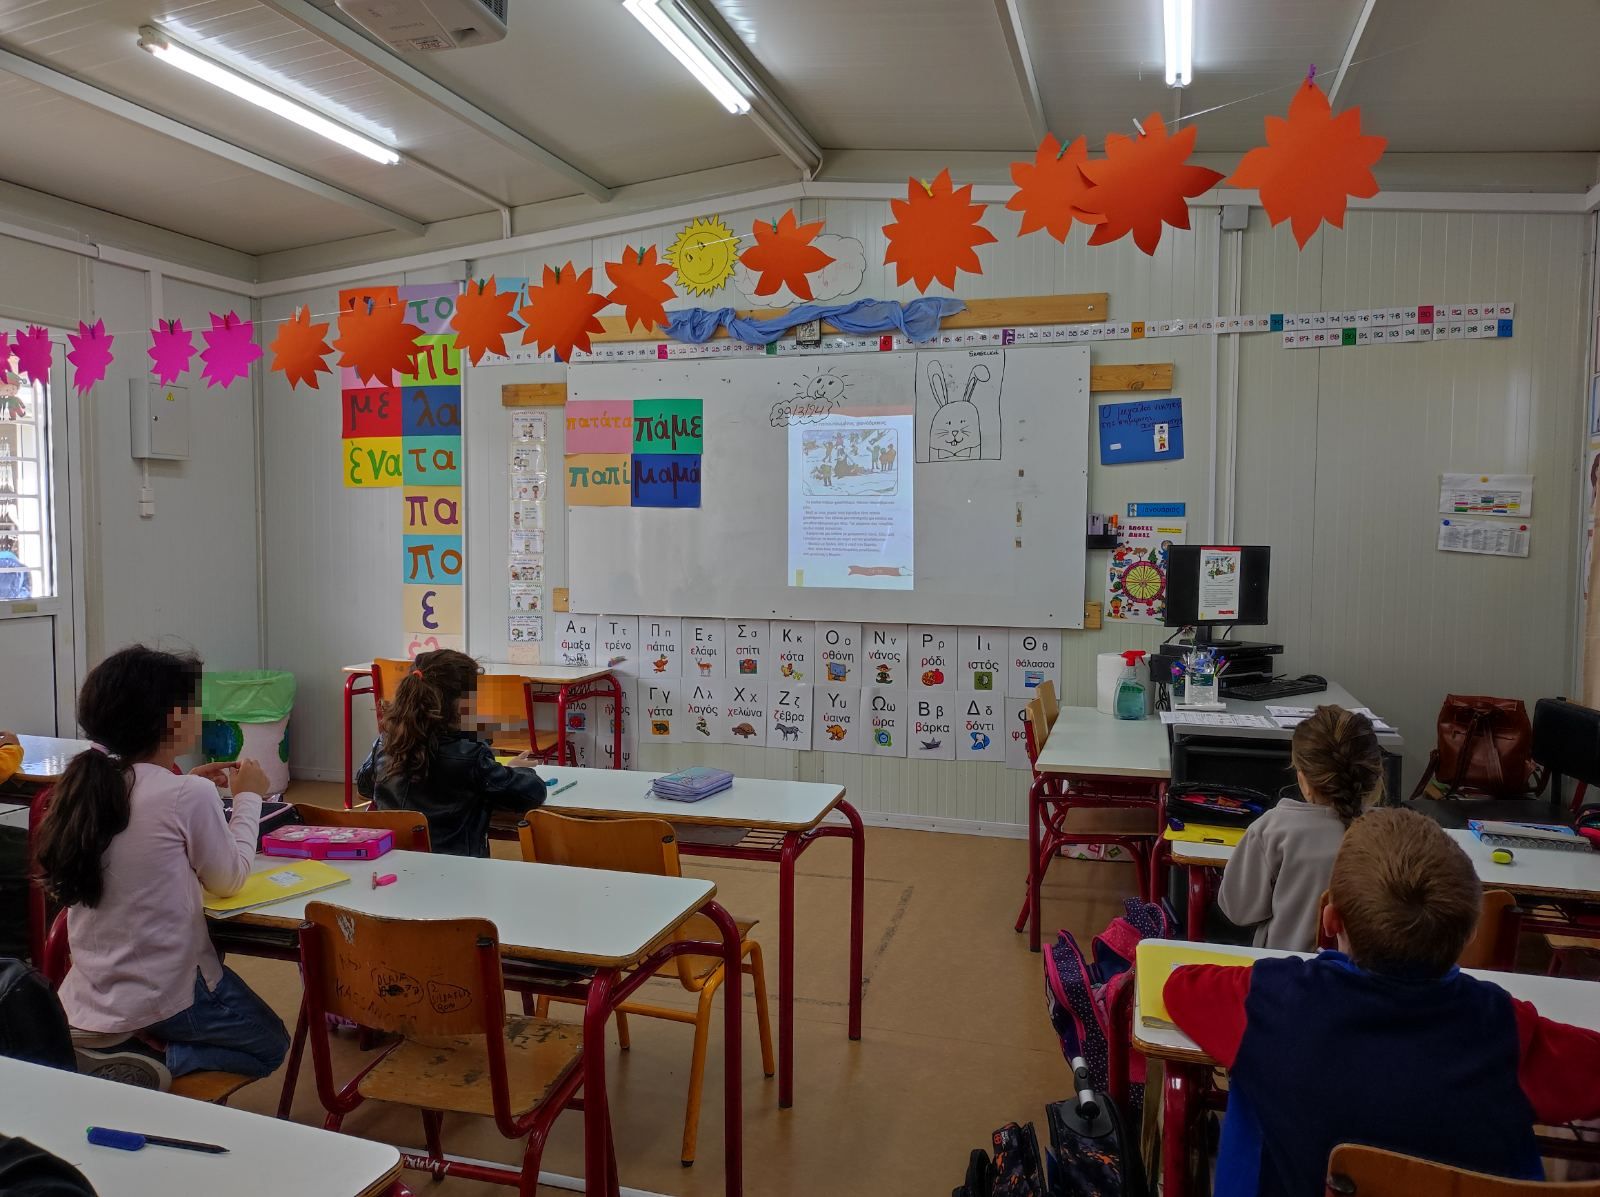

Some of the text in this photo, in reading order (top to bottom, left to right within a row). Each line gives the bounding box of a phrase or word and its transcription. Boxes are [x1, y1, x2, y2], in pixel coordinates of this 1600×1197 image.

[407, 296, 454, 324] το
[1389, 312, 1400, 320] 78
[350, 389, 461, 432] με λα
[566, 409, 703, 451] πατάτα πάμε
[407, 447, 457, 473] τα
[568, 460, 701, 500] παπί μαμά
[404, 495, 458, 527] πα
[407, 543, 463, 581] πο
[420, 589, 440, 630] ε
[566, 620, 576, 633] Α
[609, 622, 618, 635] Τ
[651, 623, 660, 637] Π
[737, 624, 747, 637] Σ
[695, 627, 703, 641] Ε
[783, 628, 792, 643] Κ
[825, 630, 840, 645] Ο
[874, 631, 886, 644] Ν
[561, 639, 591, 651] άμαξα
[604, 640, 632, 652] τρένο
[646, 640, 675, 652] πάπια
[922, 634, 933, 648] Ρ
[1023, 636, 1037, 651] Θ
[690, 645, 717, 657] ελάφι
[736, 645, 760, 656] σπίτι
[780, 651, 804, 662] κότα
[822, 650, 854, 663] οθόνη
[868, 650, 901, 662] νάνος
[921, 656, 945, 667] ρόδι
[968, 659, 999, 672] ιστός
[1015, 658, 1055, 668] θάλασσα
[649, 687, 658, 700] Γ
[693, 686, 704, 699] Λ
[734, 687, 746, 702] Χ
[779, 690, 790, 705] Ζ
[647, 707, 673, 719] γάτα
[688, 704, 718, 717] λαγός
[727, 707, 763, 718] χελώνα
[918, 701, 931, 716] Β
[967, 700, 981, 716] Δ
[773, 709, 805, 723] ζέβρα
[823, 713, 851, 724] ύαινα
[872, 716, 895, 728] ώρα
[915, 721, 950, 735] βάρκα
[965, 720, 994, 731] δόντι
